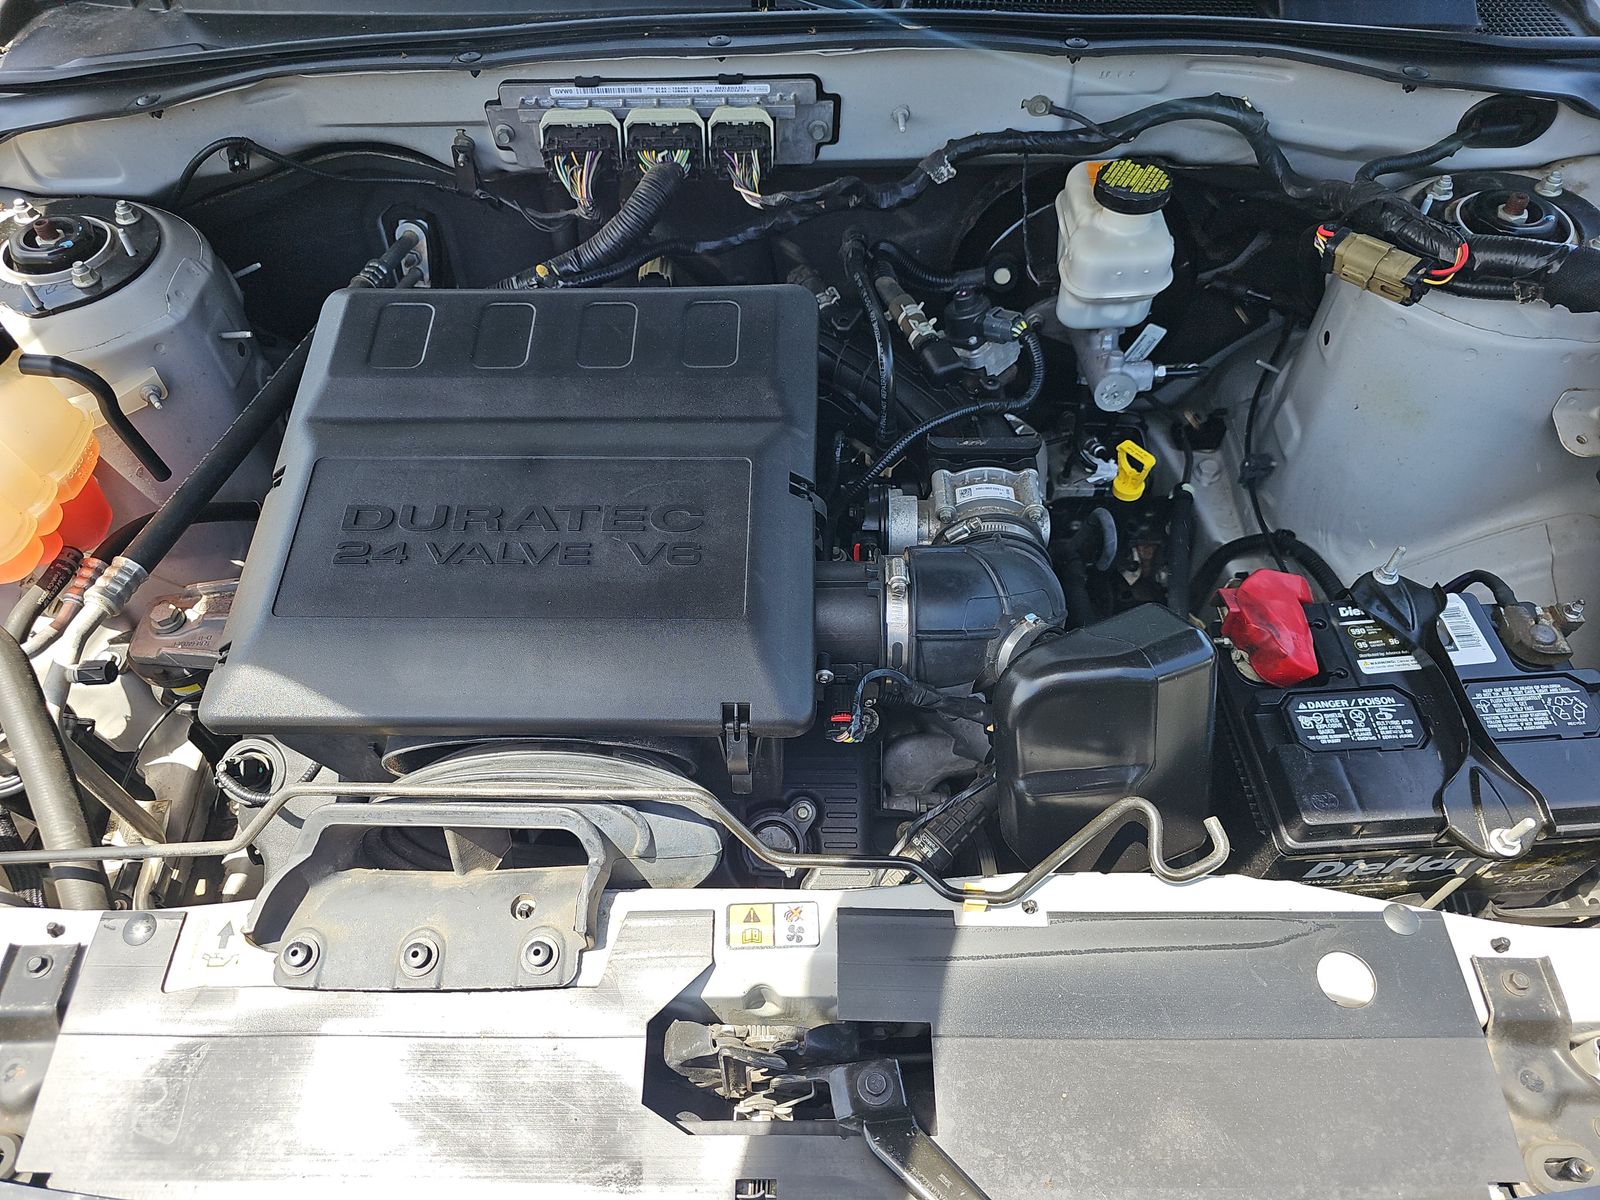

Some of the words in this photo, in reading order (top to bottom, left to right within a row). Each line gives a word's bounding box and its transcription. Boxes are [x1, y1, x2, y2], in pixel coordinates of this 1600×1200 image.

[341, 504, 704, 532] DURATEC
[332, 541, 407, 565] 24
[424, 541, 592, 566] VALVE
[625, 542, 701, 566] V6
[1338, 605, 1365, 617] Die
[1350, 627, 1366, 635] 590
[1356, 641, 1369, 649] 95
[1307, 699, 1350, 709] DANGER
[1357, 696, 1397, 706] POISON
[1302, 855, 1478, 879] DieHar
